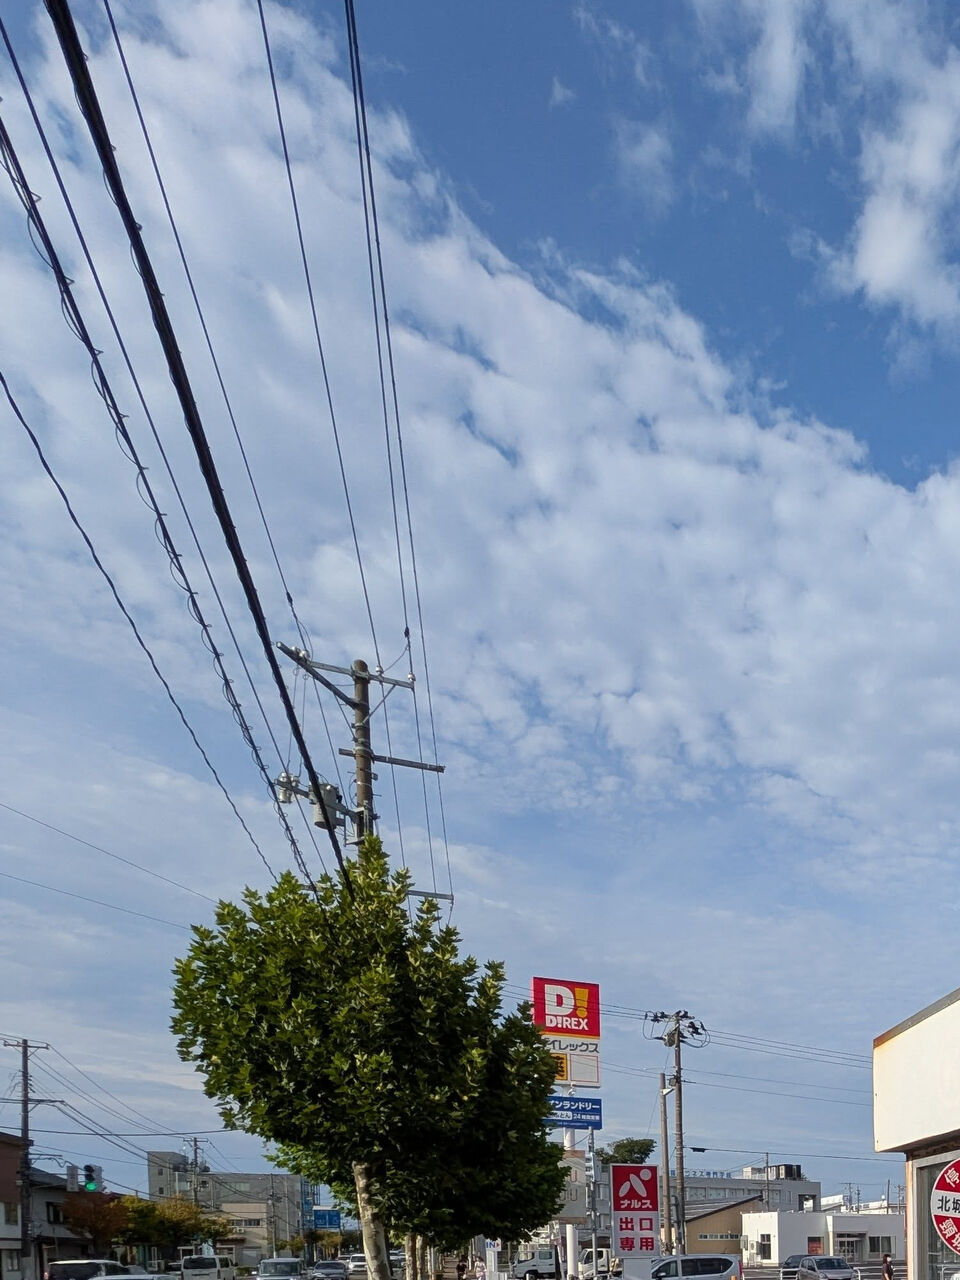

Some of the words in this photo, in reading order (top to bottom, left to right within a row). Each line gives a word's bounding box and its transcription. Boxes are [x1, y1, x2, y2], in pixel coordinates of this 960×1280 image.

[546, 1038, 599, 1054] イレックス
[620, 1199, 653, 1209] ナルス
[619, 1217, 655, 1231] 出口
[619, 1237, 655, 1252] 専用
